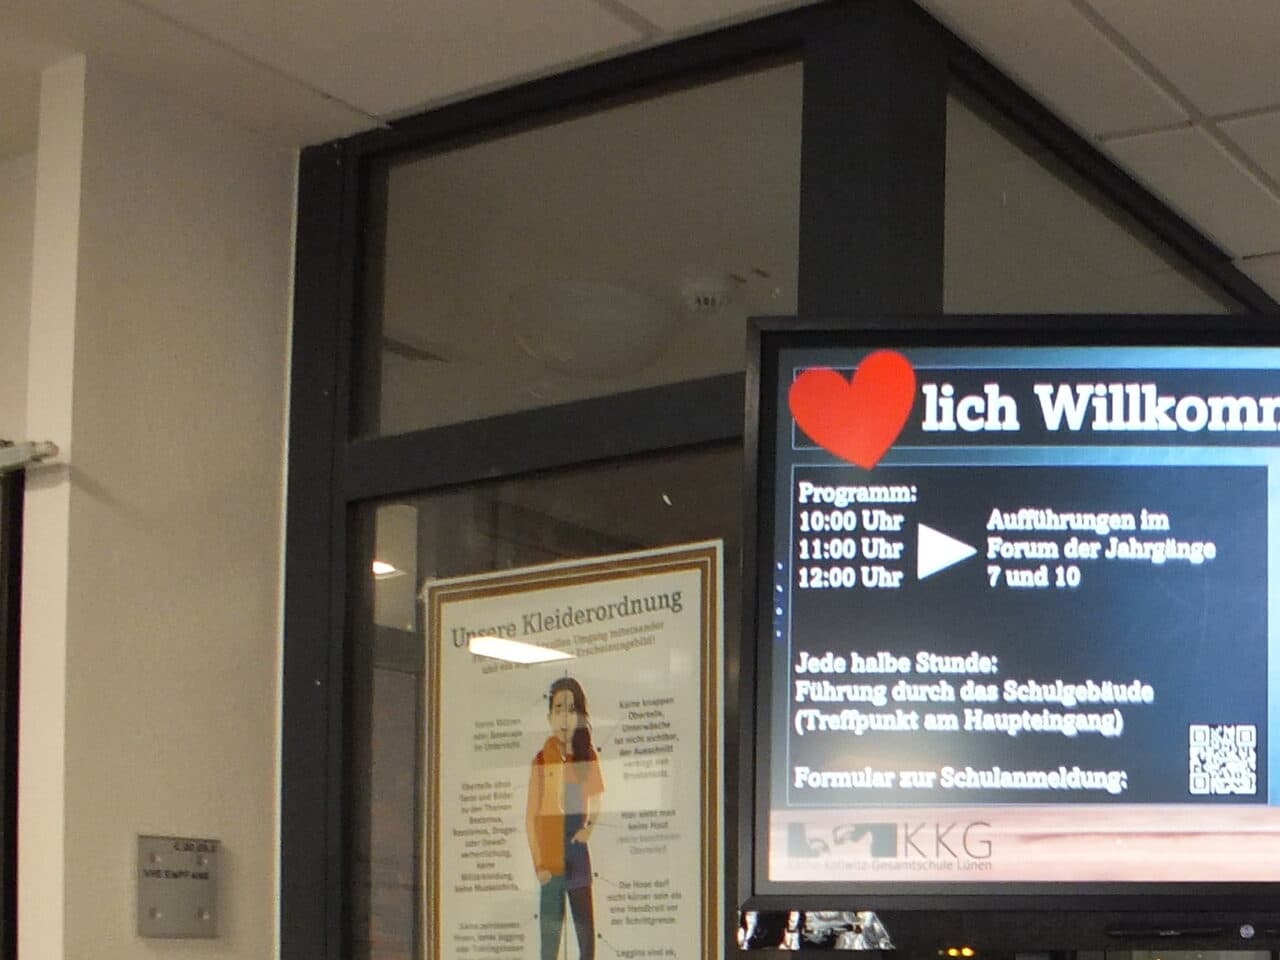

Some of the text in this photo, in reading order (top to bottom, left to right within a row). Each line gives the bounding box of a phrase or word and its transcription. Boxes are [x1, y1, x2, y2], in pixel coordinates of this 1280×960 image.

[921, 384, 1020, 431] lich
[799, 482, 917, 508] Programm:
[799, 511, 904, 532] 10:00 Uhr
[987, 509, 1169, 535] Aufführungen im
[799, 538, 904, 559] 11:00 Uhr
[987, 537, 1216, 563] Forum der Jahrgänge
[799, 566, 904, 587] 12:00 Uhr
[988, 566, 1080, 588] 7 und 10
[522, 590, 683, 636] Kleiderordnung
[794, 652, 998, 674] Jede halbe Stunde:
[795, 680, 1155, 707] Führung durch das Schulgebäude
[794, 708, 1124, 737] (Treffpunkt am Haupteingang)
[794, 767, 1128, 794] Formular zur Schulanmeldung:
[904, 821, 993, 859] KKG
